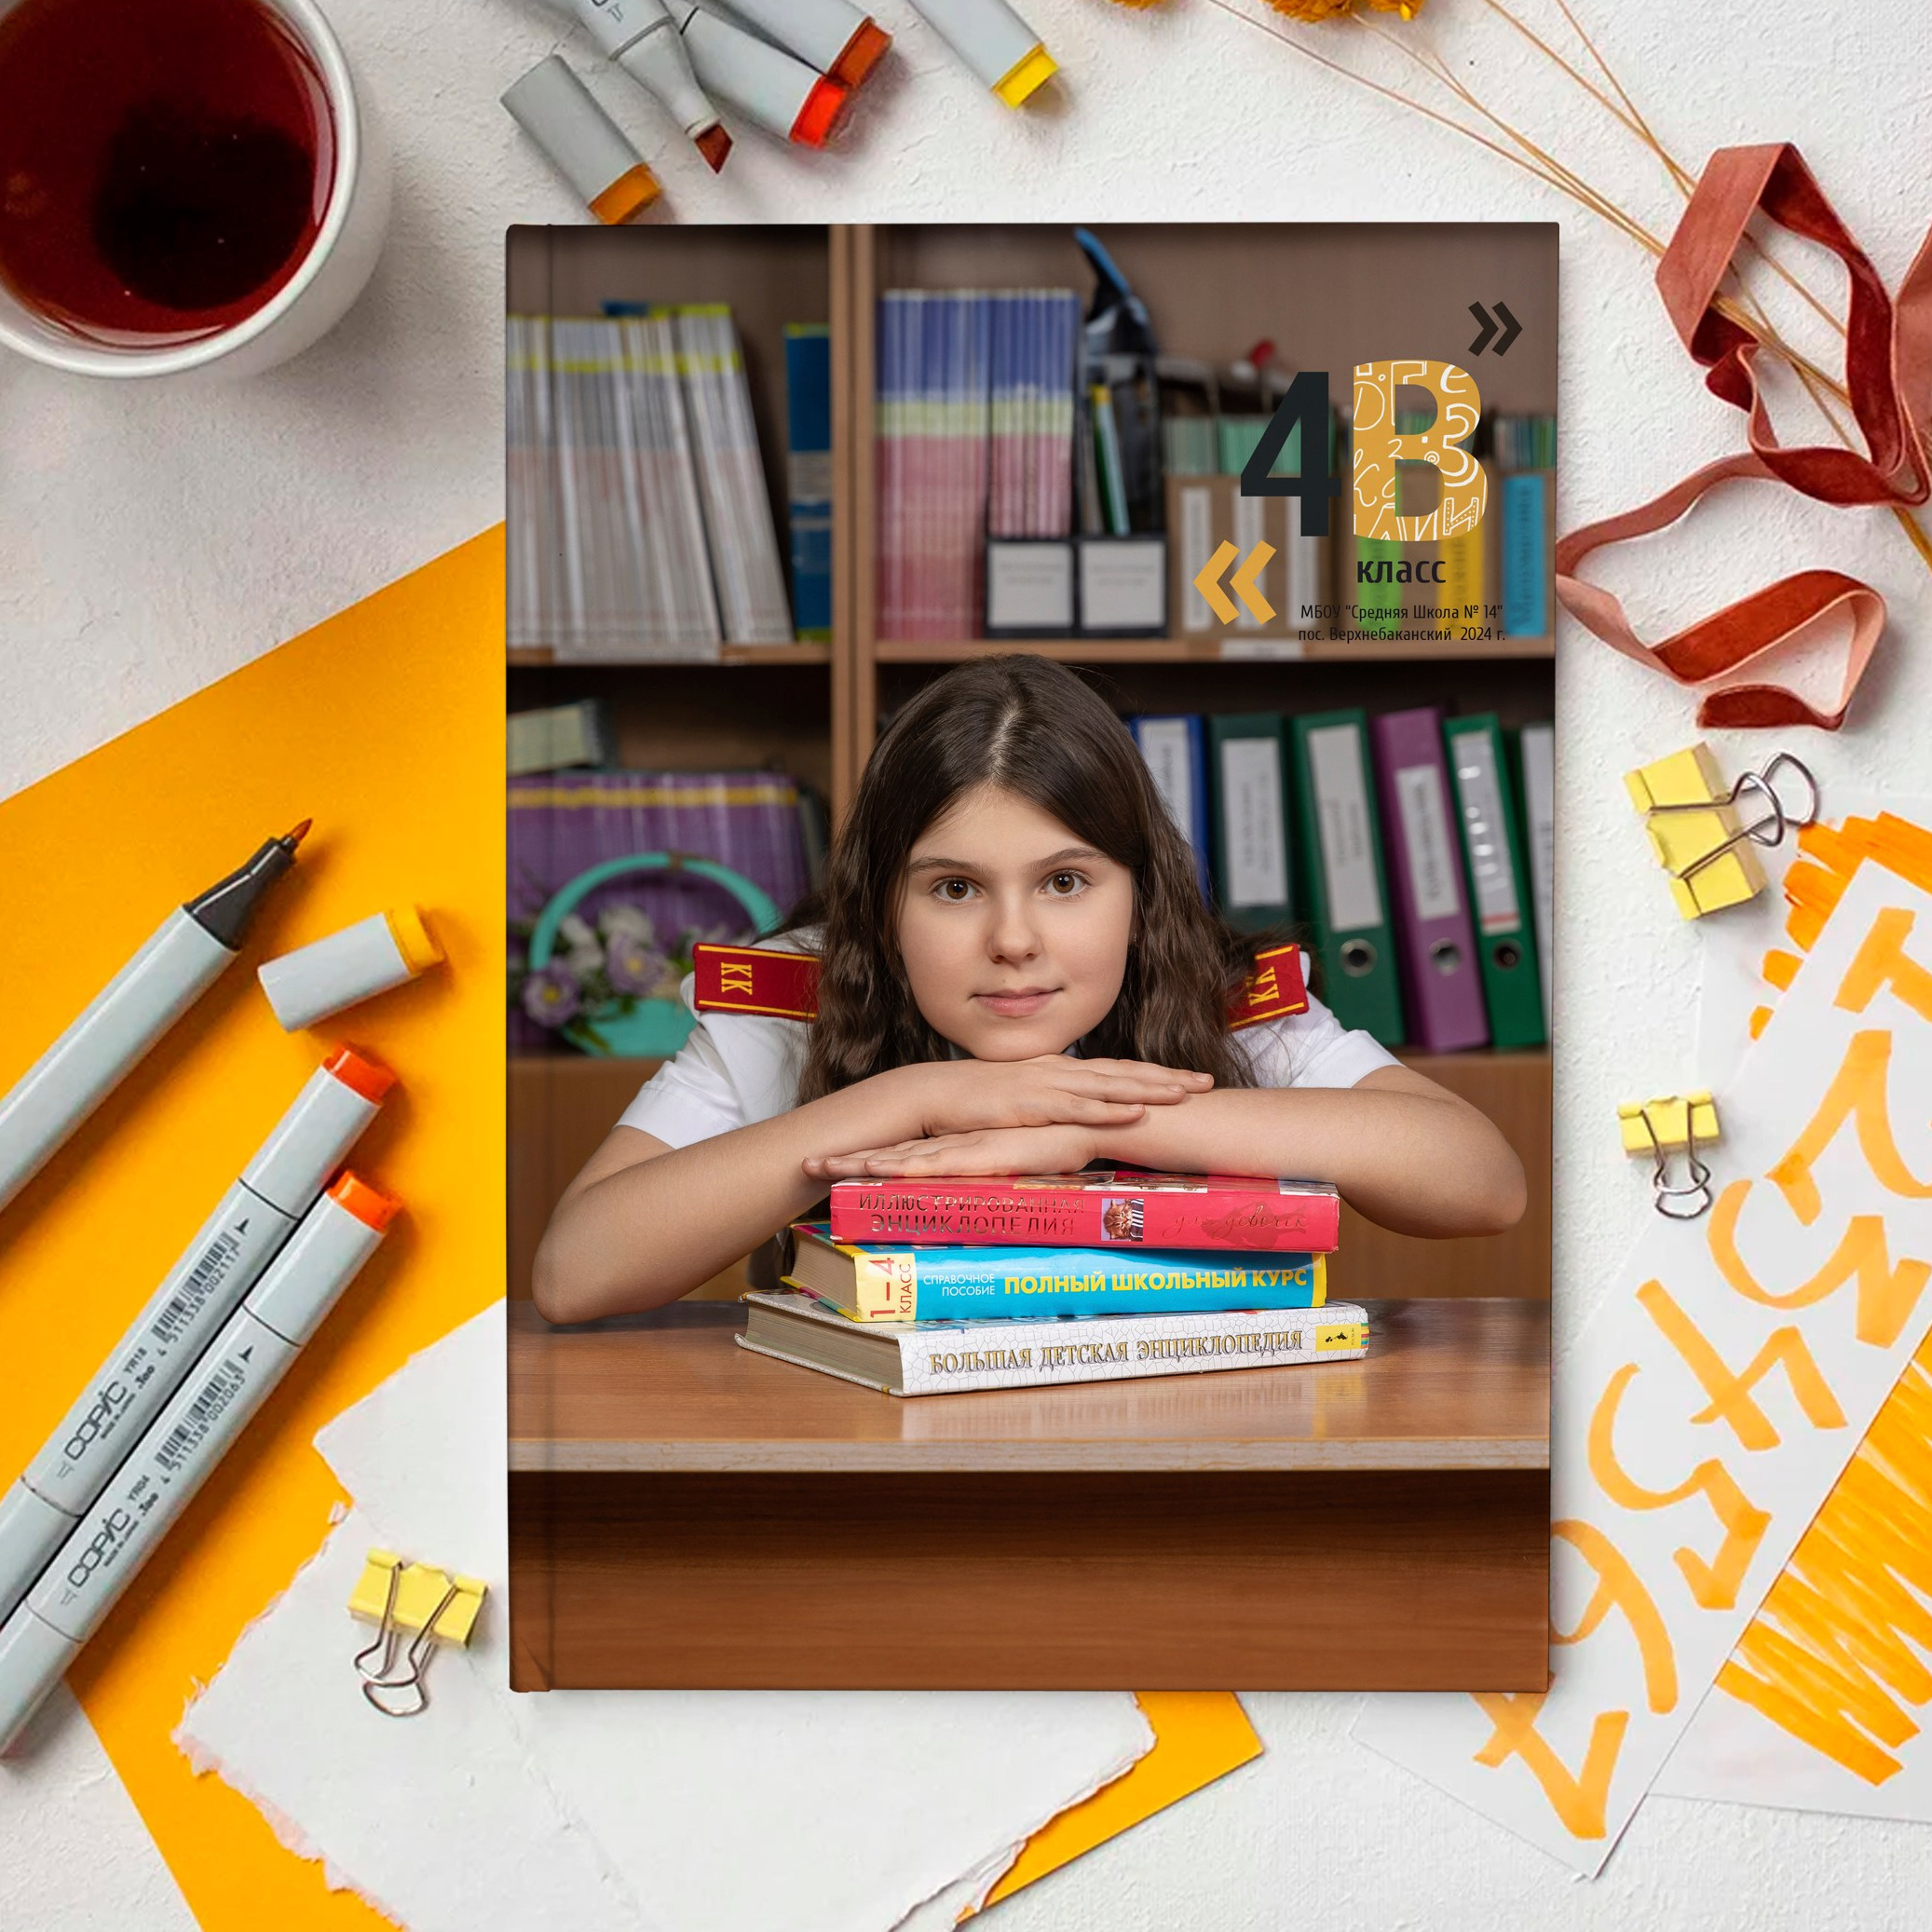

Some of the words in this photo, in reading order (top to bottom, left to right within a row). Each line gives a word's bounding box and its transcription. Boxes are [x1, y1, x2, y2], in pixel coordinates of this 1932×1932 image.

[1356, 559, 1447, 584] класс
[1300, 604, 1341, 619] МБОУ
[1413, 604, 1460, 619] Школа
[1463, 604, 1479, 619] №
[1299, 630, 1326, 642] пос.
[1329, 626, 1451, 645] Верхнебаканский
[1461, 627, 1496, 642] 2024
[859, 1193, 1085, 1214] ИЛЛЮСТРИРОВАННАЯ
[871, 1214, 1075, 1240] ЭНЦИКЛОПЕДИЯ
[900, 1263, 912, 1313] КЛАСС
[923, 1273, 995, 1286] СПРАВОЧНОЕ
[942, 1285, 996, 1297] ПОСОБИЕ
[1004, 1271, 1106, 1295] ПОЛНЫЙ
[1111, 1267, 1246, 1291] ШКОЛЬНЫЙ
[1252, 1268, 1308, 1287] КУРС
[929, 1348, 1033, 1375] БОЛЬШАЯ
[1039, 1341, 1130, 1372] ДЕТСКАЯ
[1136, 1330, 1303, 1363] ЭНЦИКЛОПЕДИЯ
